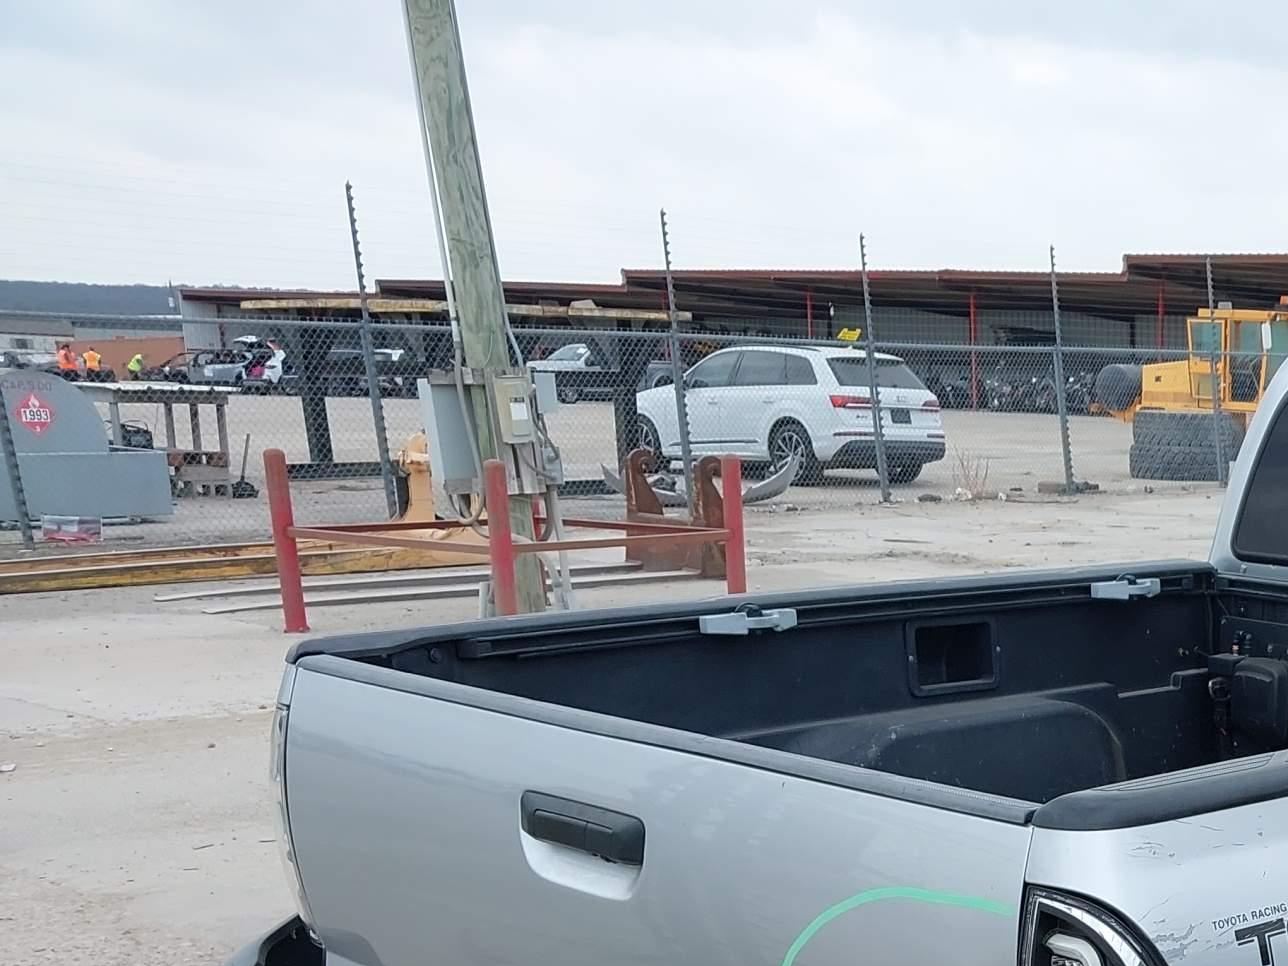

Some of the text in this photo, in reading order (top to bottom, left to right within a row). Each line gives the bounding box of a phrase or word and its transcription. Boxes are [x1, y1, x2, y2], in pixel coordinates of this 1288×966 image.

[23, 409, 49, 421] 1993
[1212, 911, 1249, 931] TOYOTA
[1251, 904, 1288, 921] RACING
